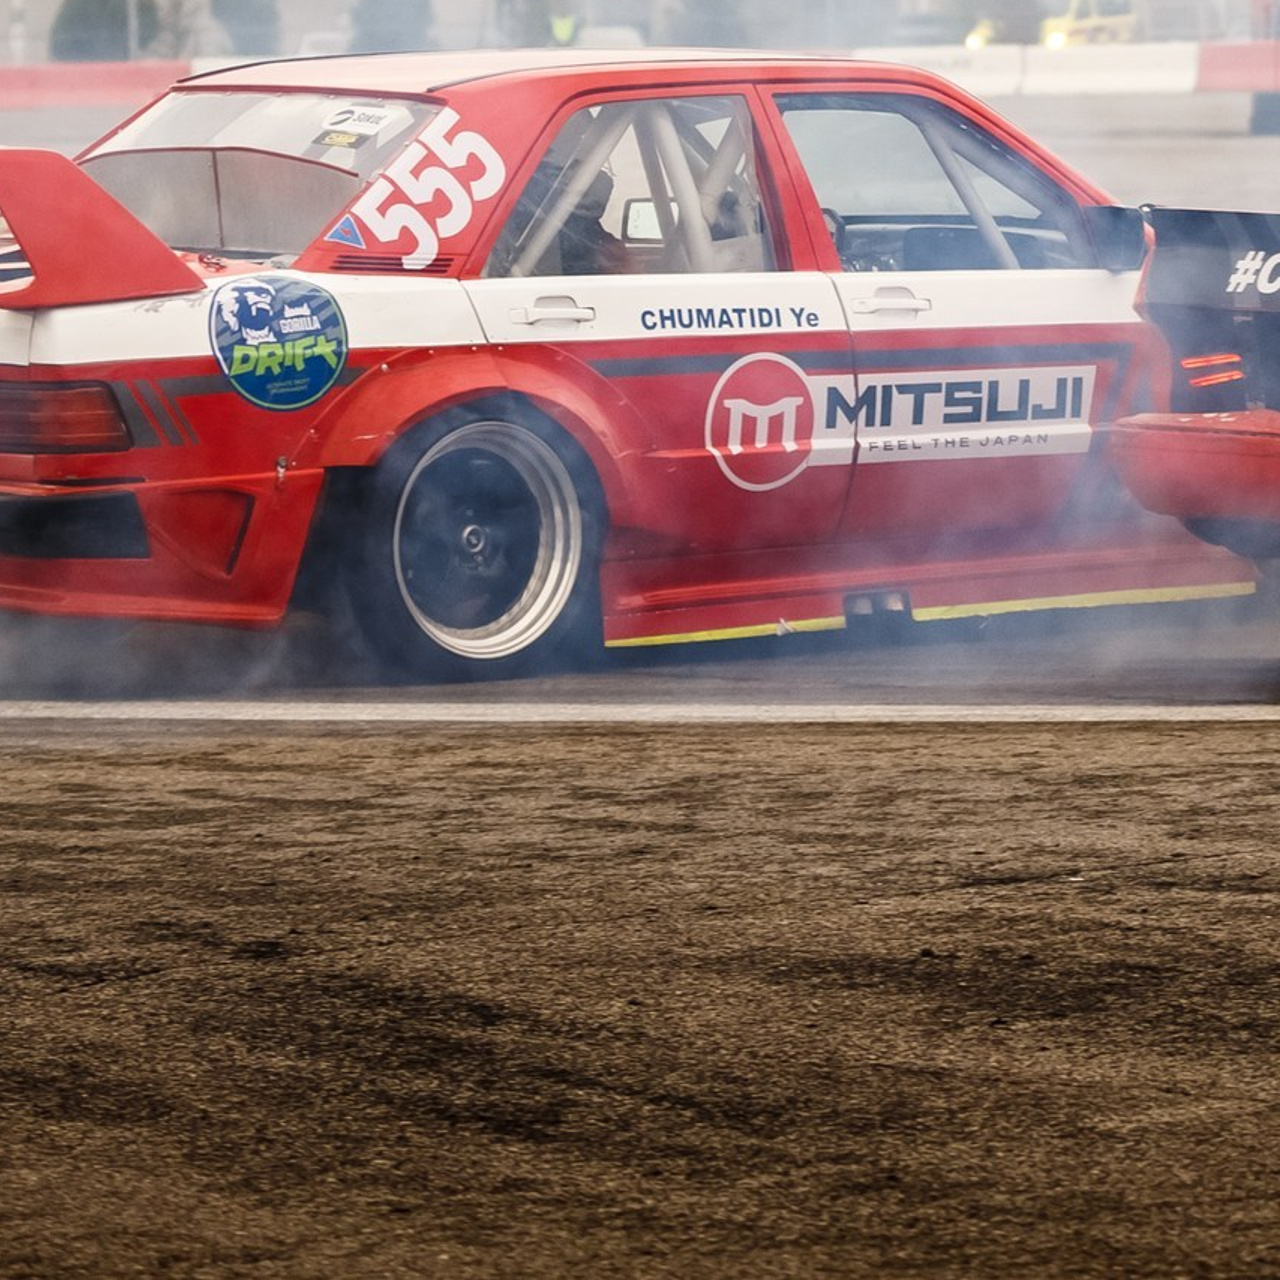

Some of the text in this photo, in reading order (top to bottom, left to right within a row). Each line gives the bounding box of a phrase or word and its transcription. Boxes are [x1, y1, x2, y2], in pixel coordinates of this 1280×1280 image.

[350, 106, 507, 270] 555
[640, 307, 820, 330] CHUMATIDI Ye
[825, 377, 1083, 429] MITSUJI
[867, 434, 1050, 452] FEEL THE JAPAN
